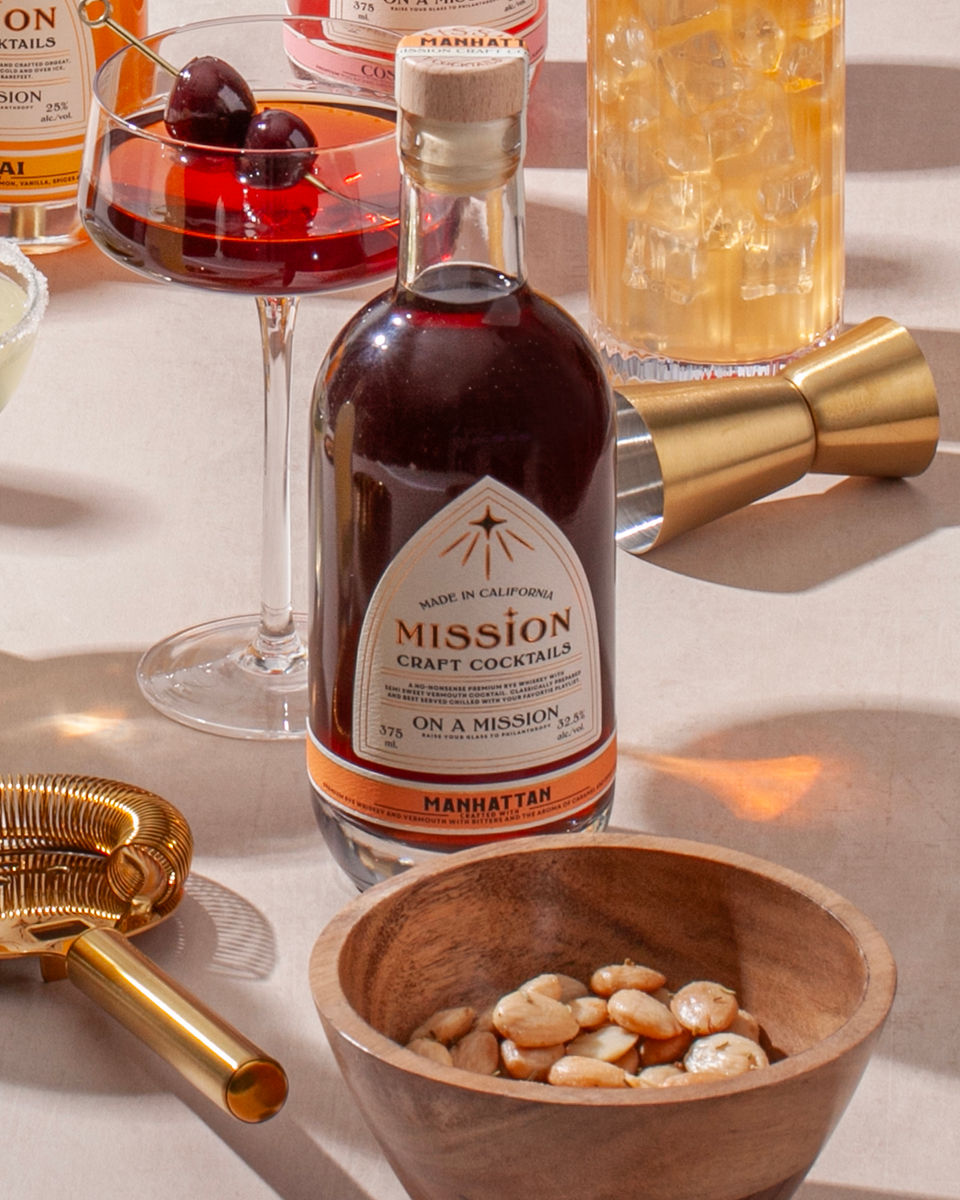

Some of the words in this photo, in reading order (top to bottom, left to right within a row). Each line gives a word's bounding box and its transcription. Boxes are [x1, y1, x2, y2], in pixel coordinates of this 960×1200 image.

[353, 1, 375, 12] 375
[46, 101, 69, 112] 25%
[419, 592, 457, 610] MADE
[461, 590, 475, 600] IN
[479, 587, 554, 600] CALIFORNIA
[395, 606, 572, 650] MISSION
[397, 654, 462, 671] CRAFT
[470, 641, 572, 671] COCKTAILS
[519, 676, 547, 686] WHISKEY
[412, 715, 443, 731] ON
[451, 719, 466, 732] A
[473, 705, 559, 732] MISSION
[557, 710, 586, 729] 32.5%
[379, 724, 403, 739] 375
[424, 786, 551, 812] MANHATTAN
[404, 814, 447, 824] VERMOUTH
[471, 817, 502, 825] BITTERS
[537, 803, 562, 816] AROMA
[460, 811, 496, 819] CRAFTED
